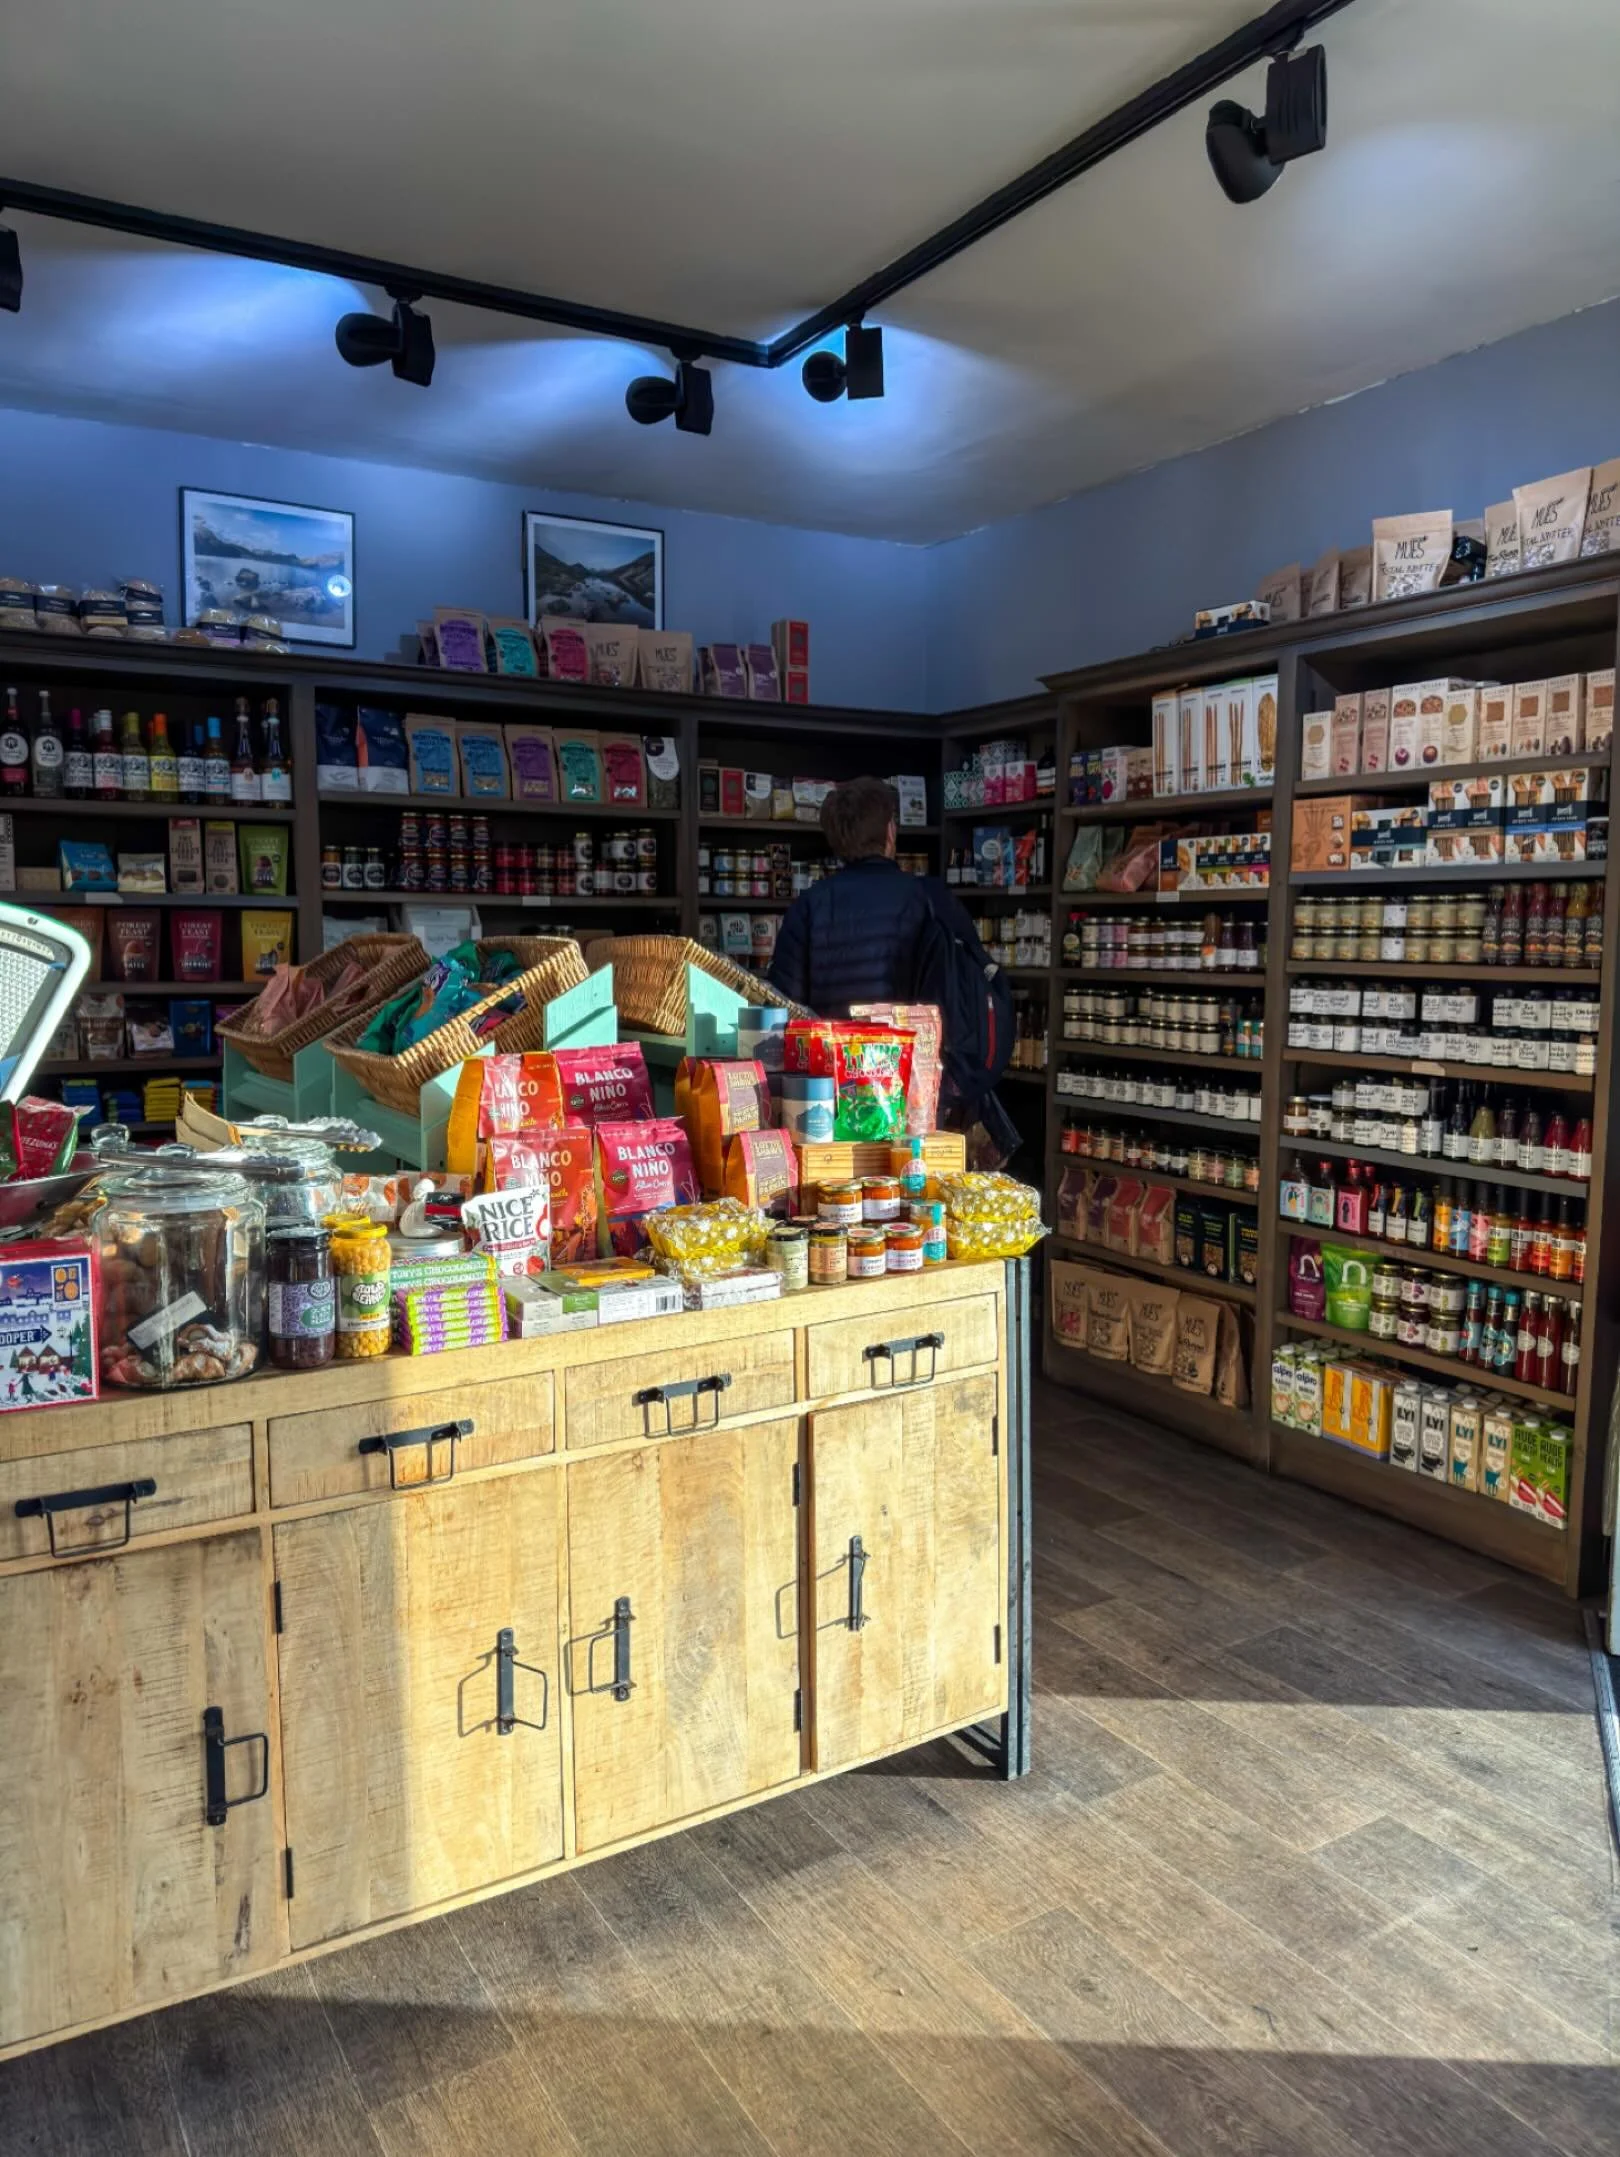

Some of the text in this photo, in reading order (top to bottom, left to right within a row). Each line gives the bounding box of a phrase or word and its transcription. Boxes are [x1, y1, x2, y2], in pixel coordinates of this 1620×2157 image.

[574, 1067, 634, 1087] BLANCO
[589, 1082, 627, 1102] NIÑO
[511, 1151, 572, 1169] BLANCO
[617, 1143, 676, 1161] BLANCO
[632, 1158, 670, 1179] NIÑO
[478, 1196, 535, 1221] NICE
[483, 1216, 535, 1242] RICE
[1273, 1364, 1293, 1379] alpro
[1296, 1372, 1317, 1386] alpro
